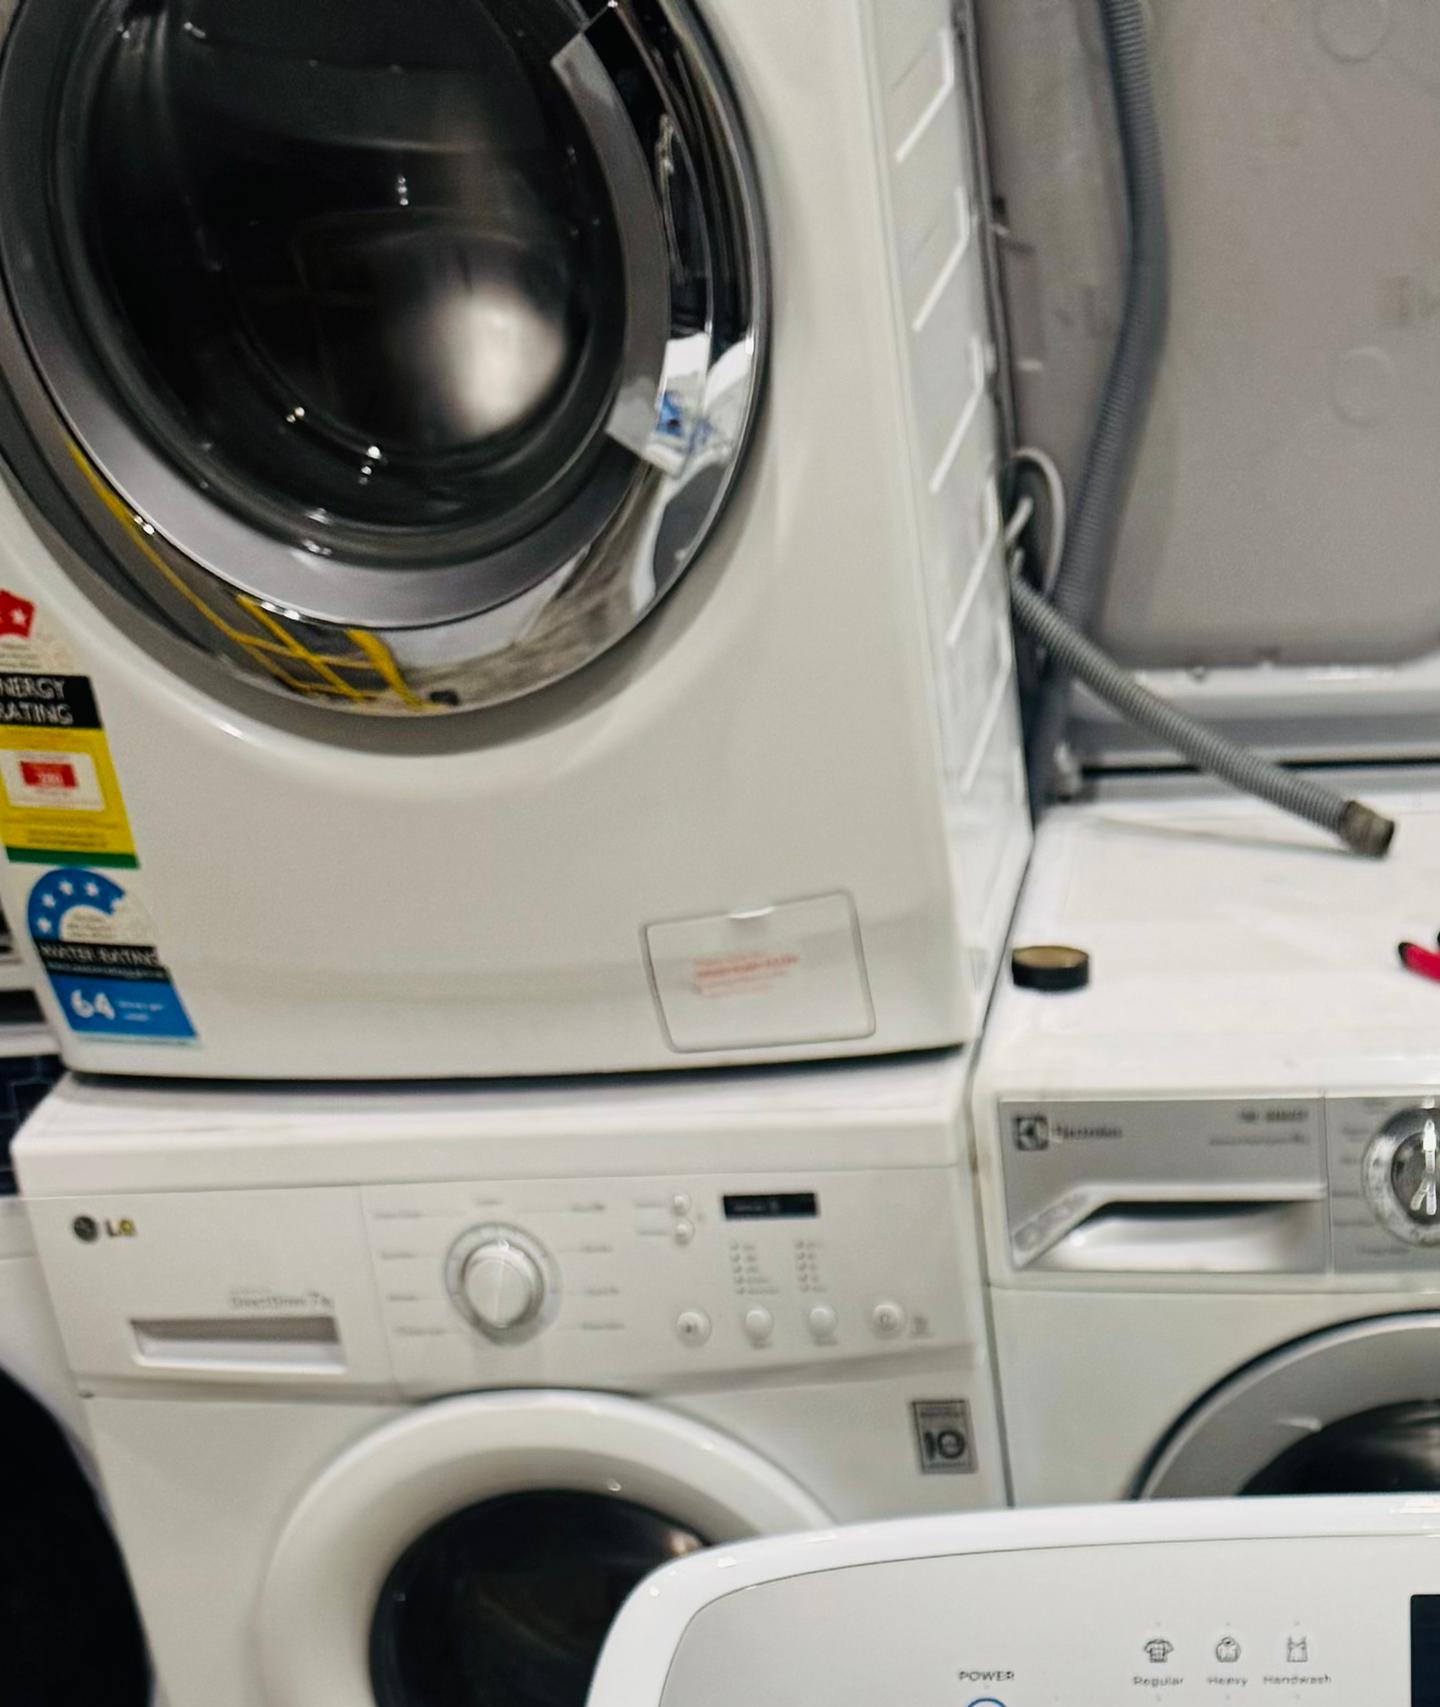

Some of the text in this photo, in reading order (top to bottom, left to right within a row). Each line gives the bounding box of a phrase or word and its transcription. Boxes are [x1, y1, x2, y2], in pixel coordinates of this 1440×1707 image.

[0, 677, 65, 700] NERGY
[71, 989, 116, 1021] 64
[958, 1670, 1015, 1682] POWER
[1132, 1675, 1184, 1688] Regular
[1263, 1674, 1332, 1685] Handwash
